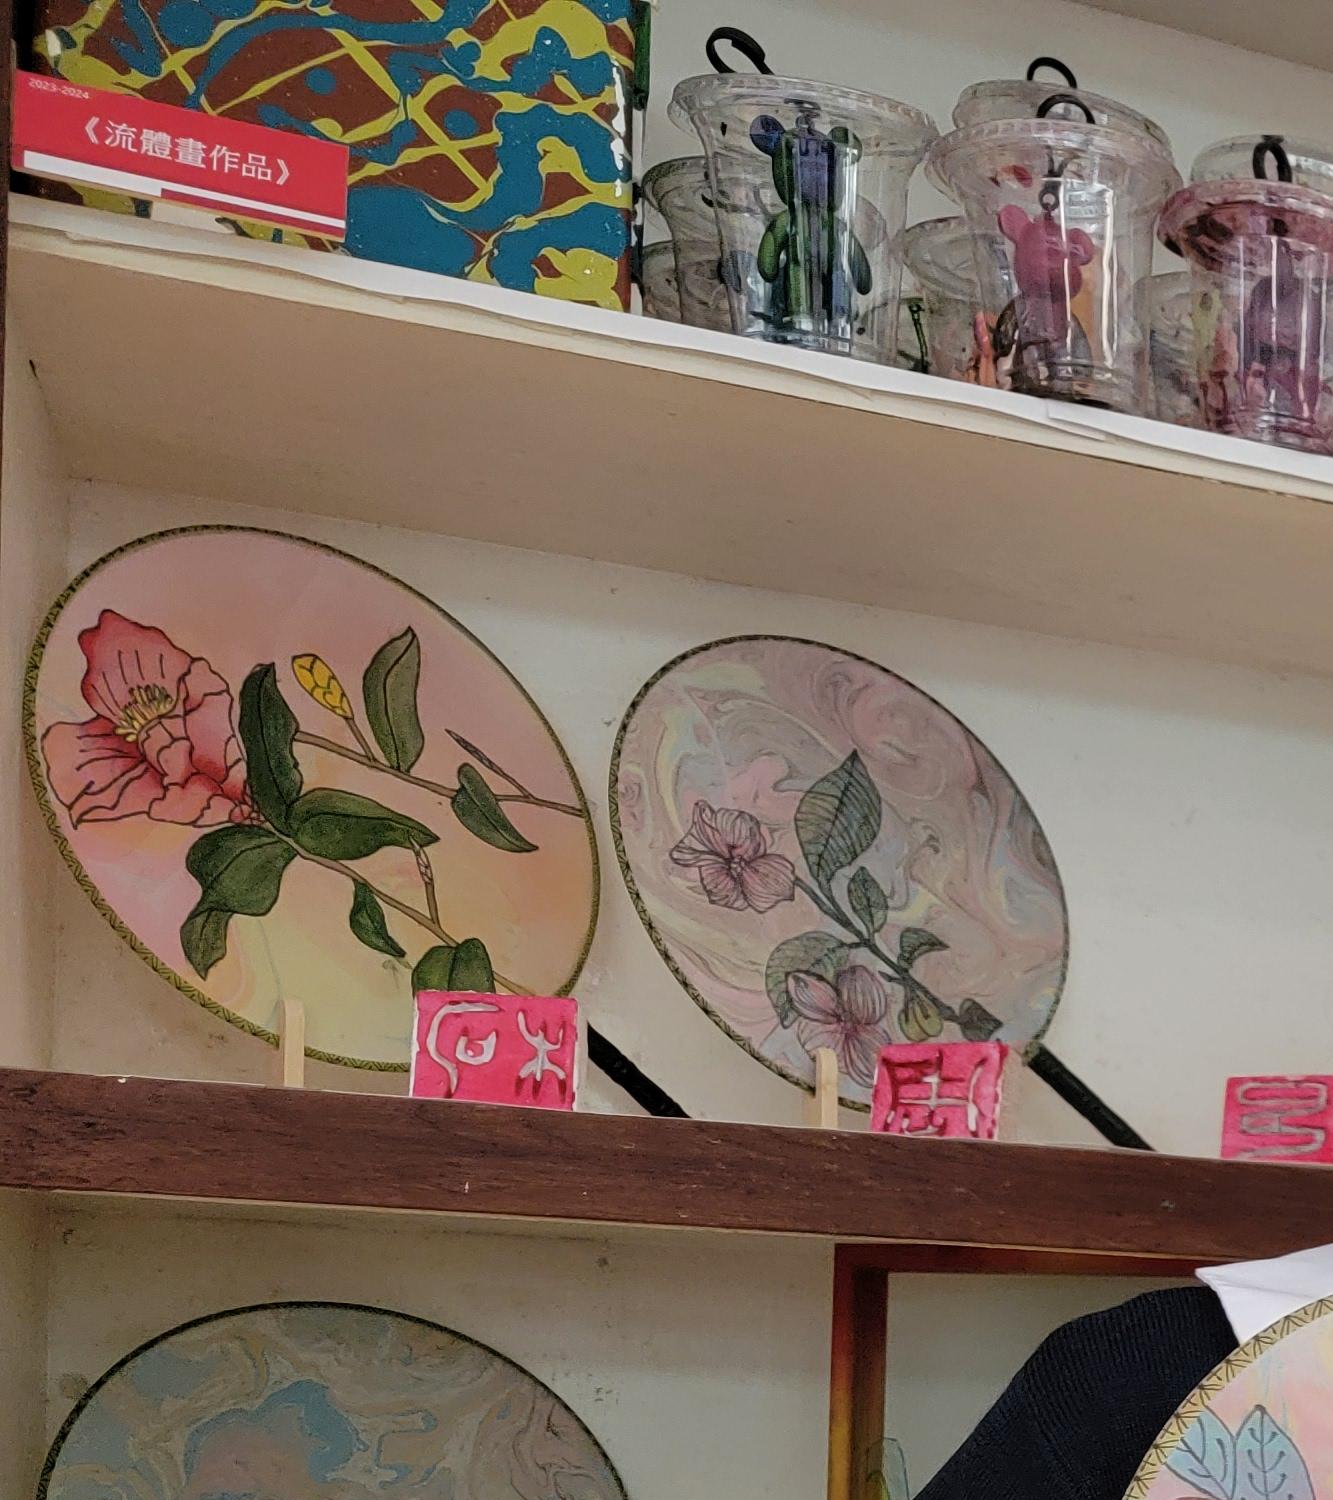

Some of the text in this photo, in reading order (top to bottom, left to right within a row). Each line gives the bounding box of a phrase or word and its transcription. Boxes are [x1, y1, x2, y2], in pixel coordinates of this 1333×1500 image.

[28, 78, 89, 99] 2023-2024
[84, 116, 290, 186] 《流體畫作品》
